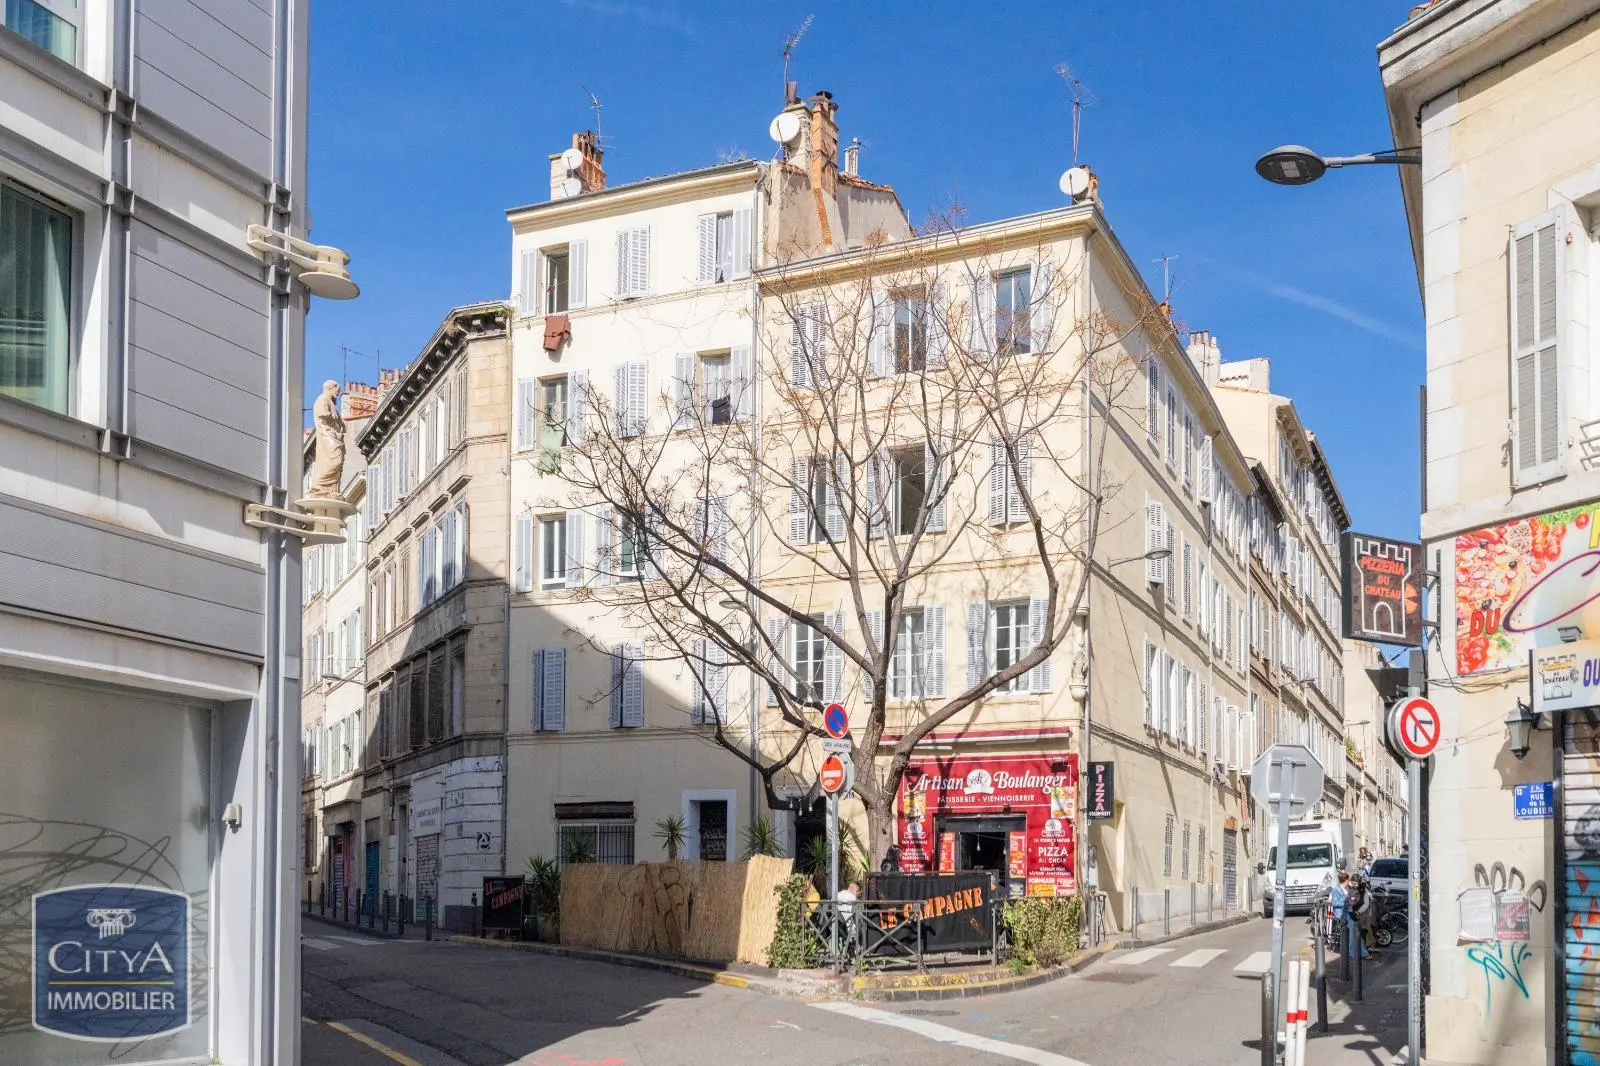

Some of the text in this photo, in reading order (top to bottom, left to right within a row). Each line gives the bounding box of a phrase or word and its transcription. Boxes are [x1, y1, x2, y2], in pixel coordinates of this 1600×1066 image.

[1360, 555, 1405, 576] PIZZERIA
[1377, 575, 1390, 585] DU
[1470, 608, 1501, 637] DU
[907, 770, 1067, 794] Artisan Boulanger
[1095, 764, 1105, 811] PIZZA
[982, 794, 1035, 802] VIENNOISERIE
[1516, 807, 1553, 815] LOUBIER
[1038, 846, 1069, 857] PIZZA
